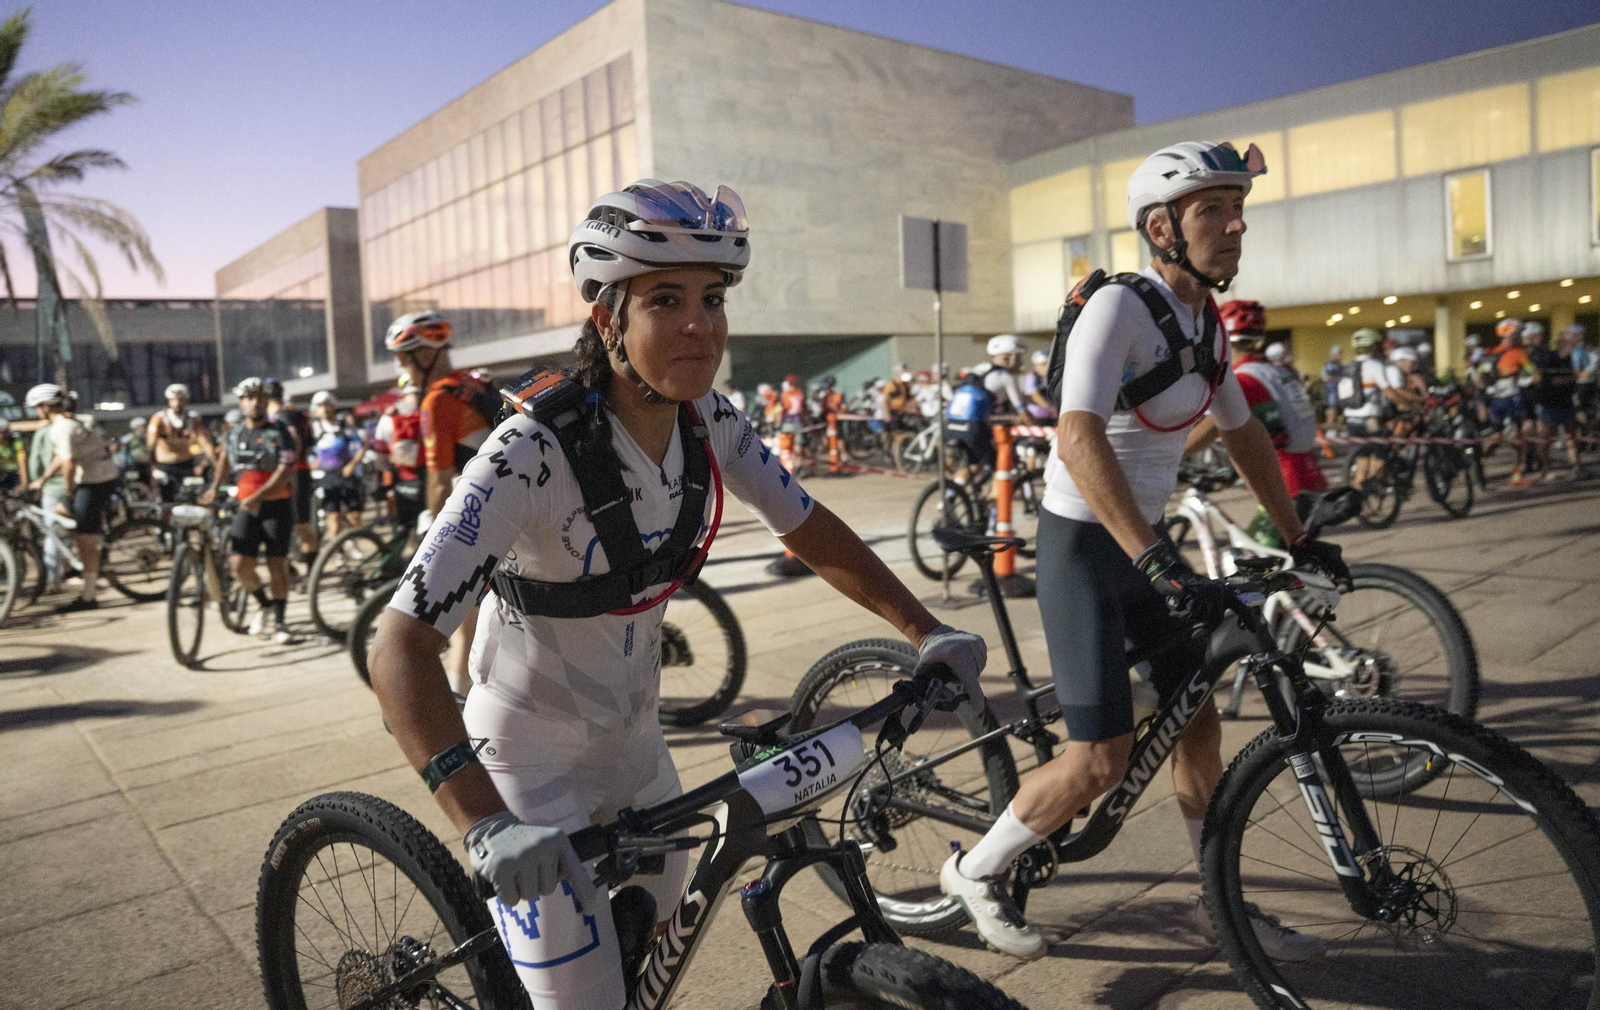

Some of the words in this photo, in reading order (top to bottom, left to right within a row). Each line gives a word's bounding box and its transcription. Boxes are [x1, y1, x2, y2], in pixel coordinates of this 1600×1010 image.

[586, 220, 621, 238] GIRO
[453, 482, 493, 546] Team
[421, 521, 456, 564] Racing
[772, 739, 836, 788] 351
[1107, 669, 1210, 824] S-WORKS
[794, 773, 837, 804] NATALIA
